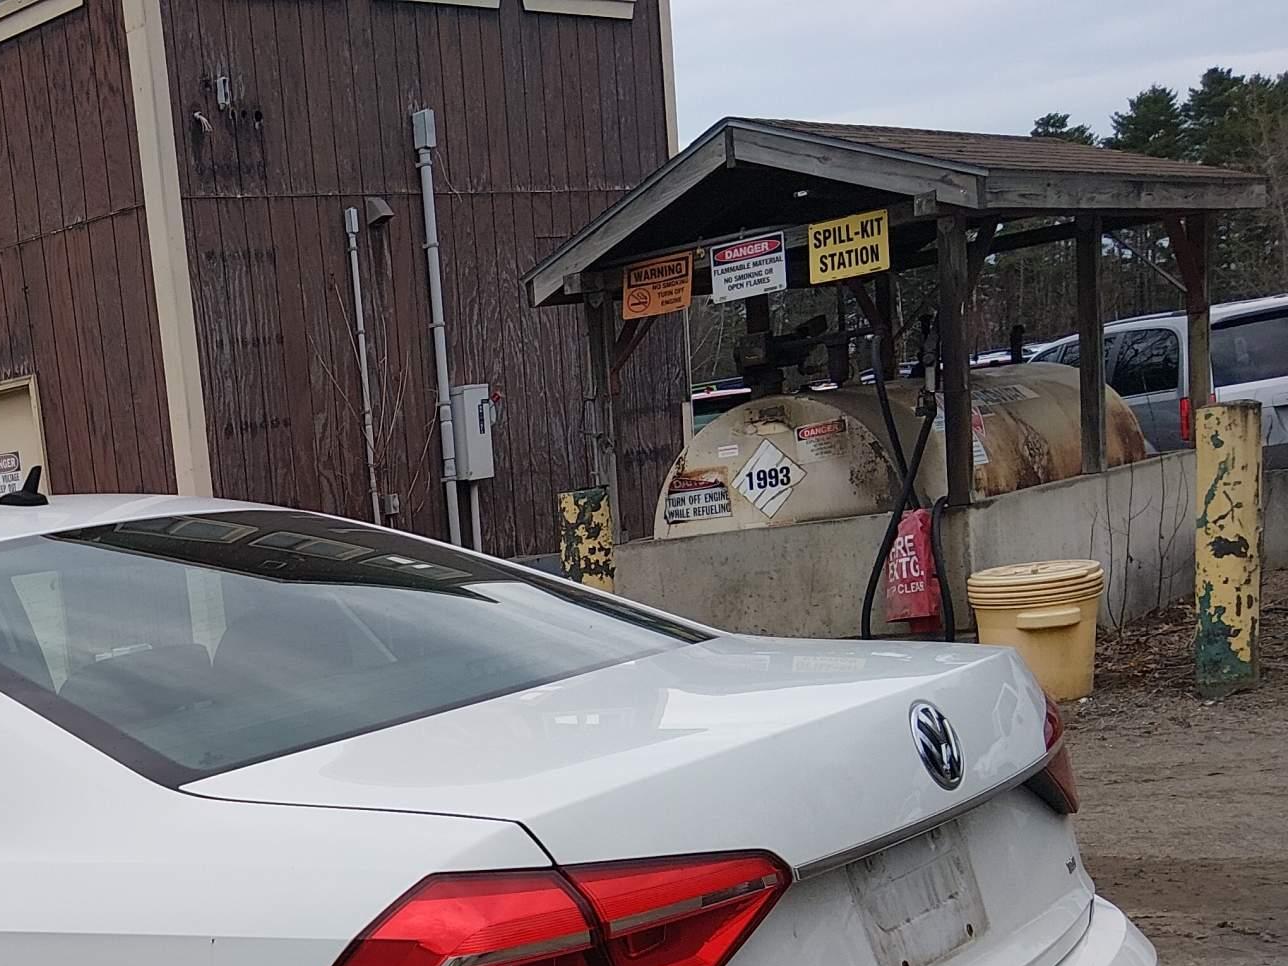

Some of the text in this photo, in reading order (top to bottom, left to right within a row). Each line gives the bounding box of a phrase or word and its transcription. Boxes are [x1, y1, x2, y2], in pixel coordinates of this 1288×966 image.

[813, 216, 883, 249] SPILL-KIT
[724, 241, 769, 260] DANGER
[819, 244, 880, 273] STATION
[633, 262, 683, 282] WARNING
[713, 255, 784, 277] FLAMMABLE MATERIAL
[723, 267, 774, 285] NO SMOKING OR
[727, 282, 745, 291] OPEN
[745, 277, 771, 288] FLAMES
[803, 422, 841, 437] DANGER
[745, 466, 791, 491] 1993
[667, 491, 730, 508] TURN OFF ENGINE
[668, 508, 691, 520] WHILE
